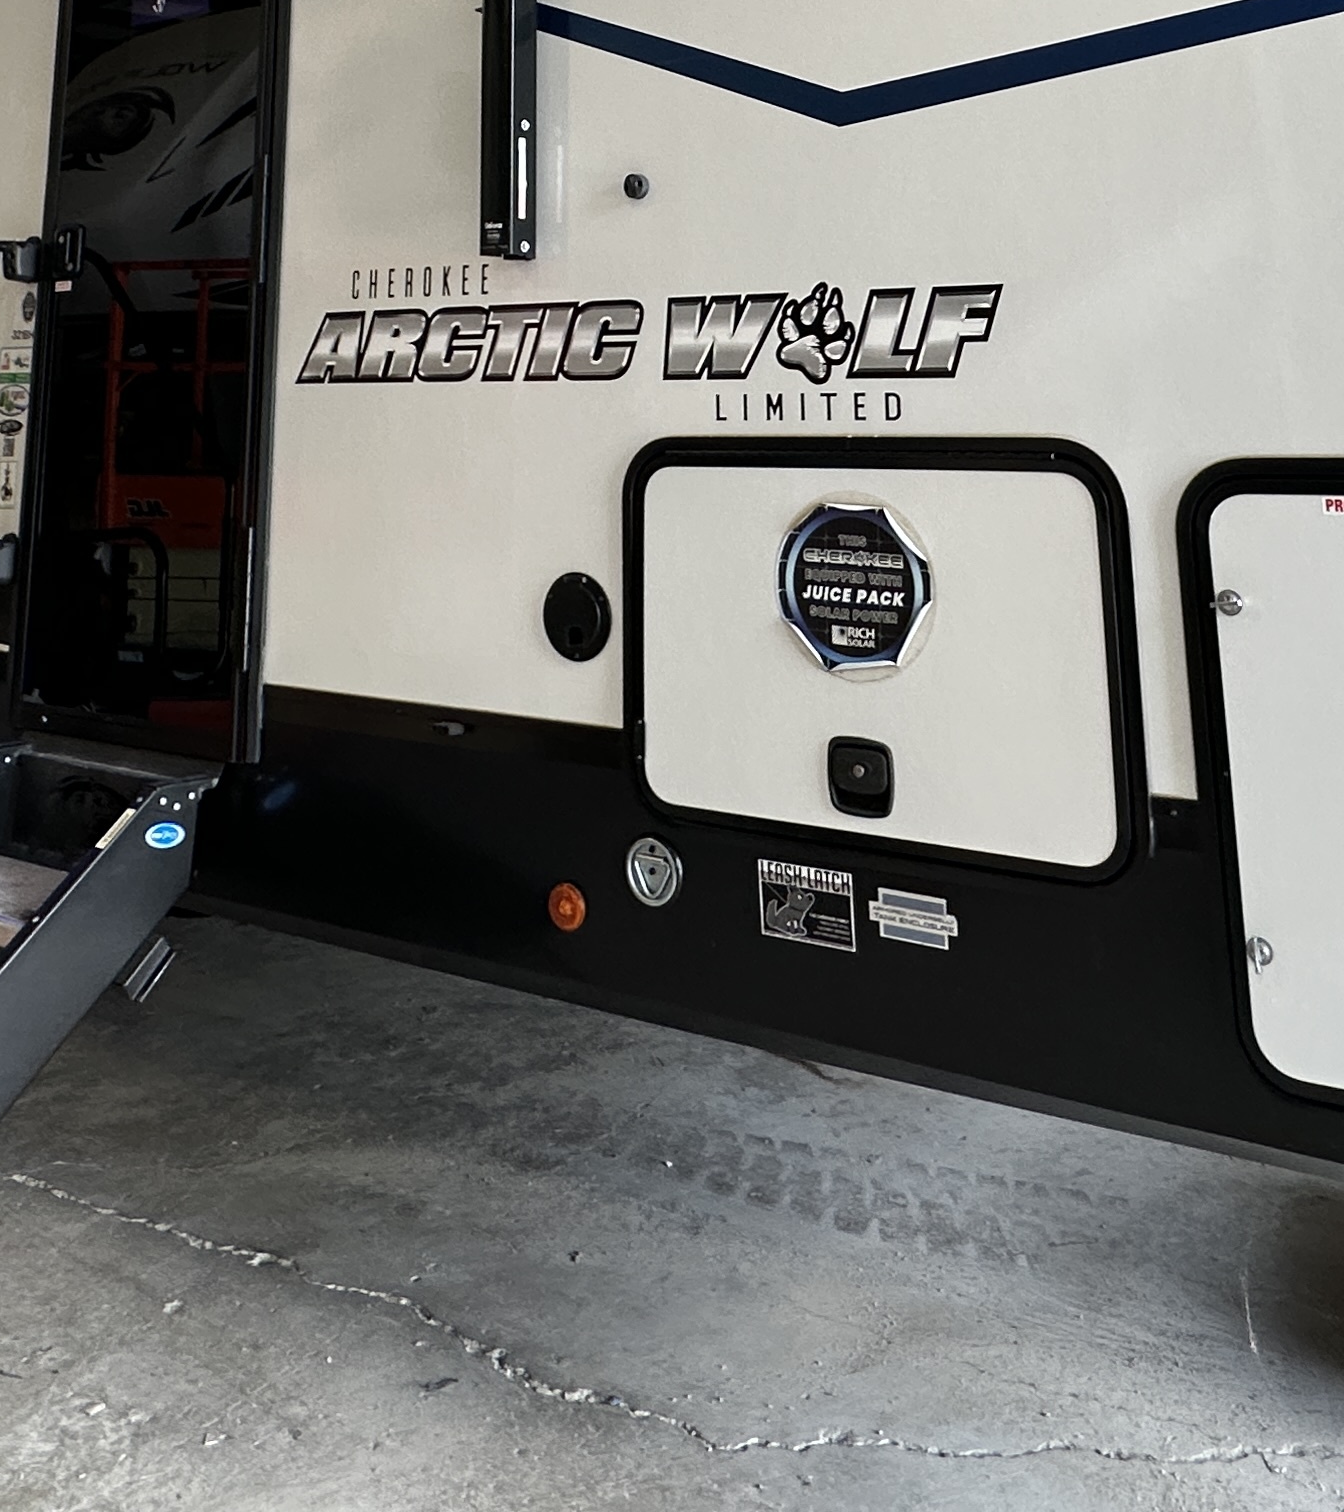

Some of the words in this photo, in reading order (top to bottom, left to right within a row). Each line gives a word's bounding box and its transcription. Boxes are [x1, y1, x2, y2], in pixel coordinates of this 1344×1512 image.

[352, 263, 491, 300] CHEROKEE
[296, 299, 644, 384] ARCTIC
[662, 283, 1004, 384] WLF
[715, 392, 902, 422] LIMITED
[837, 534, 867, 548] THIS
[803, 548, 904, 569] CHEROKEE
[805, 568, 866, 584] EQUIPPED
[868, 573, 903, 587] WITH
[801, 584, 852, 603] JUICE
[856, 590, 906, 607] PACK
[809, 604, 850, 620] SOLAR
[852, 609, 898, 624] POWER
[847, 626, 875, 639] RICH
